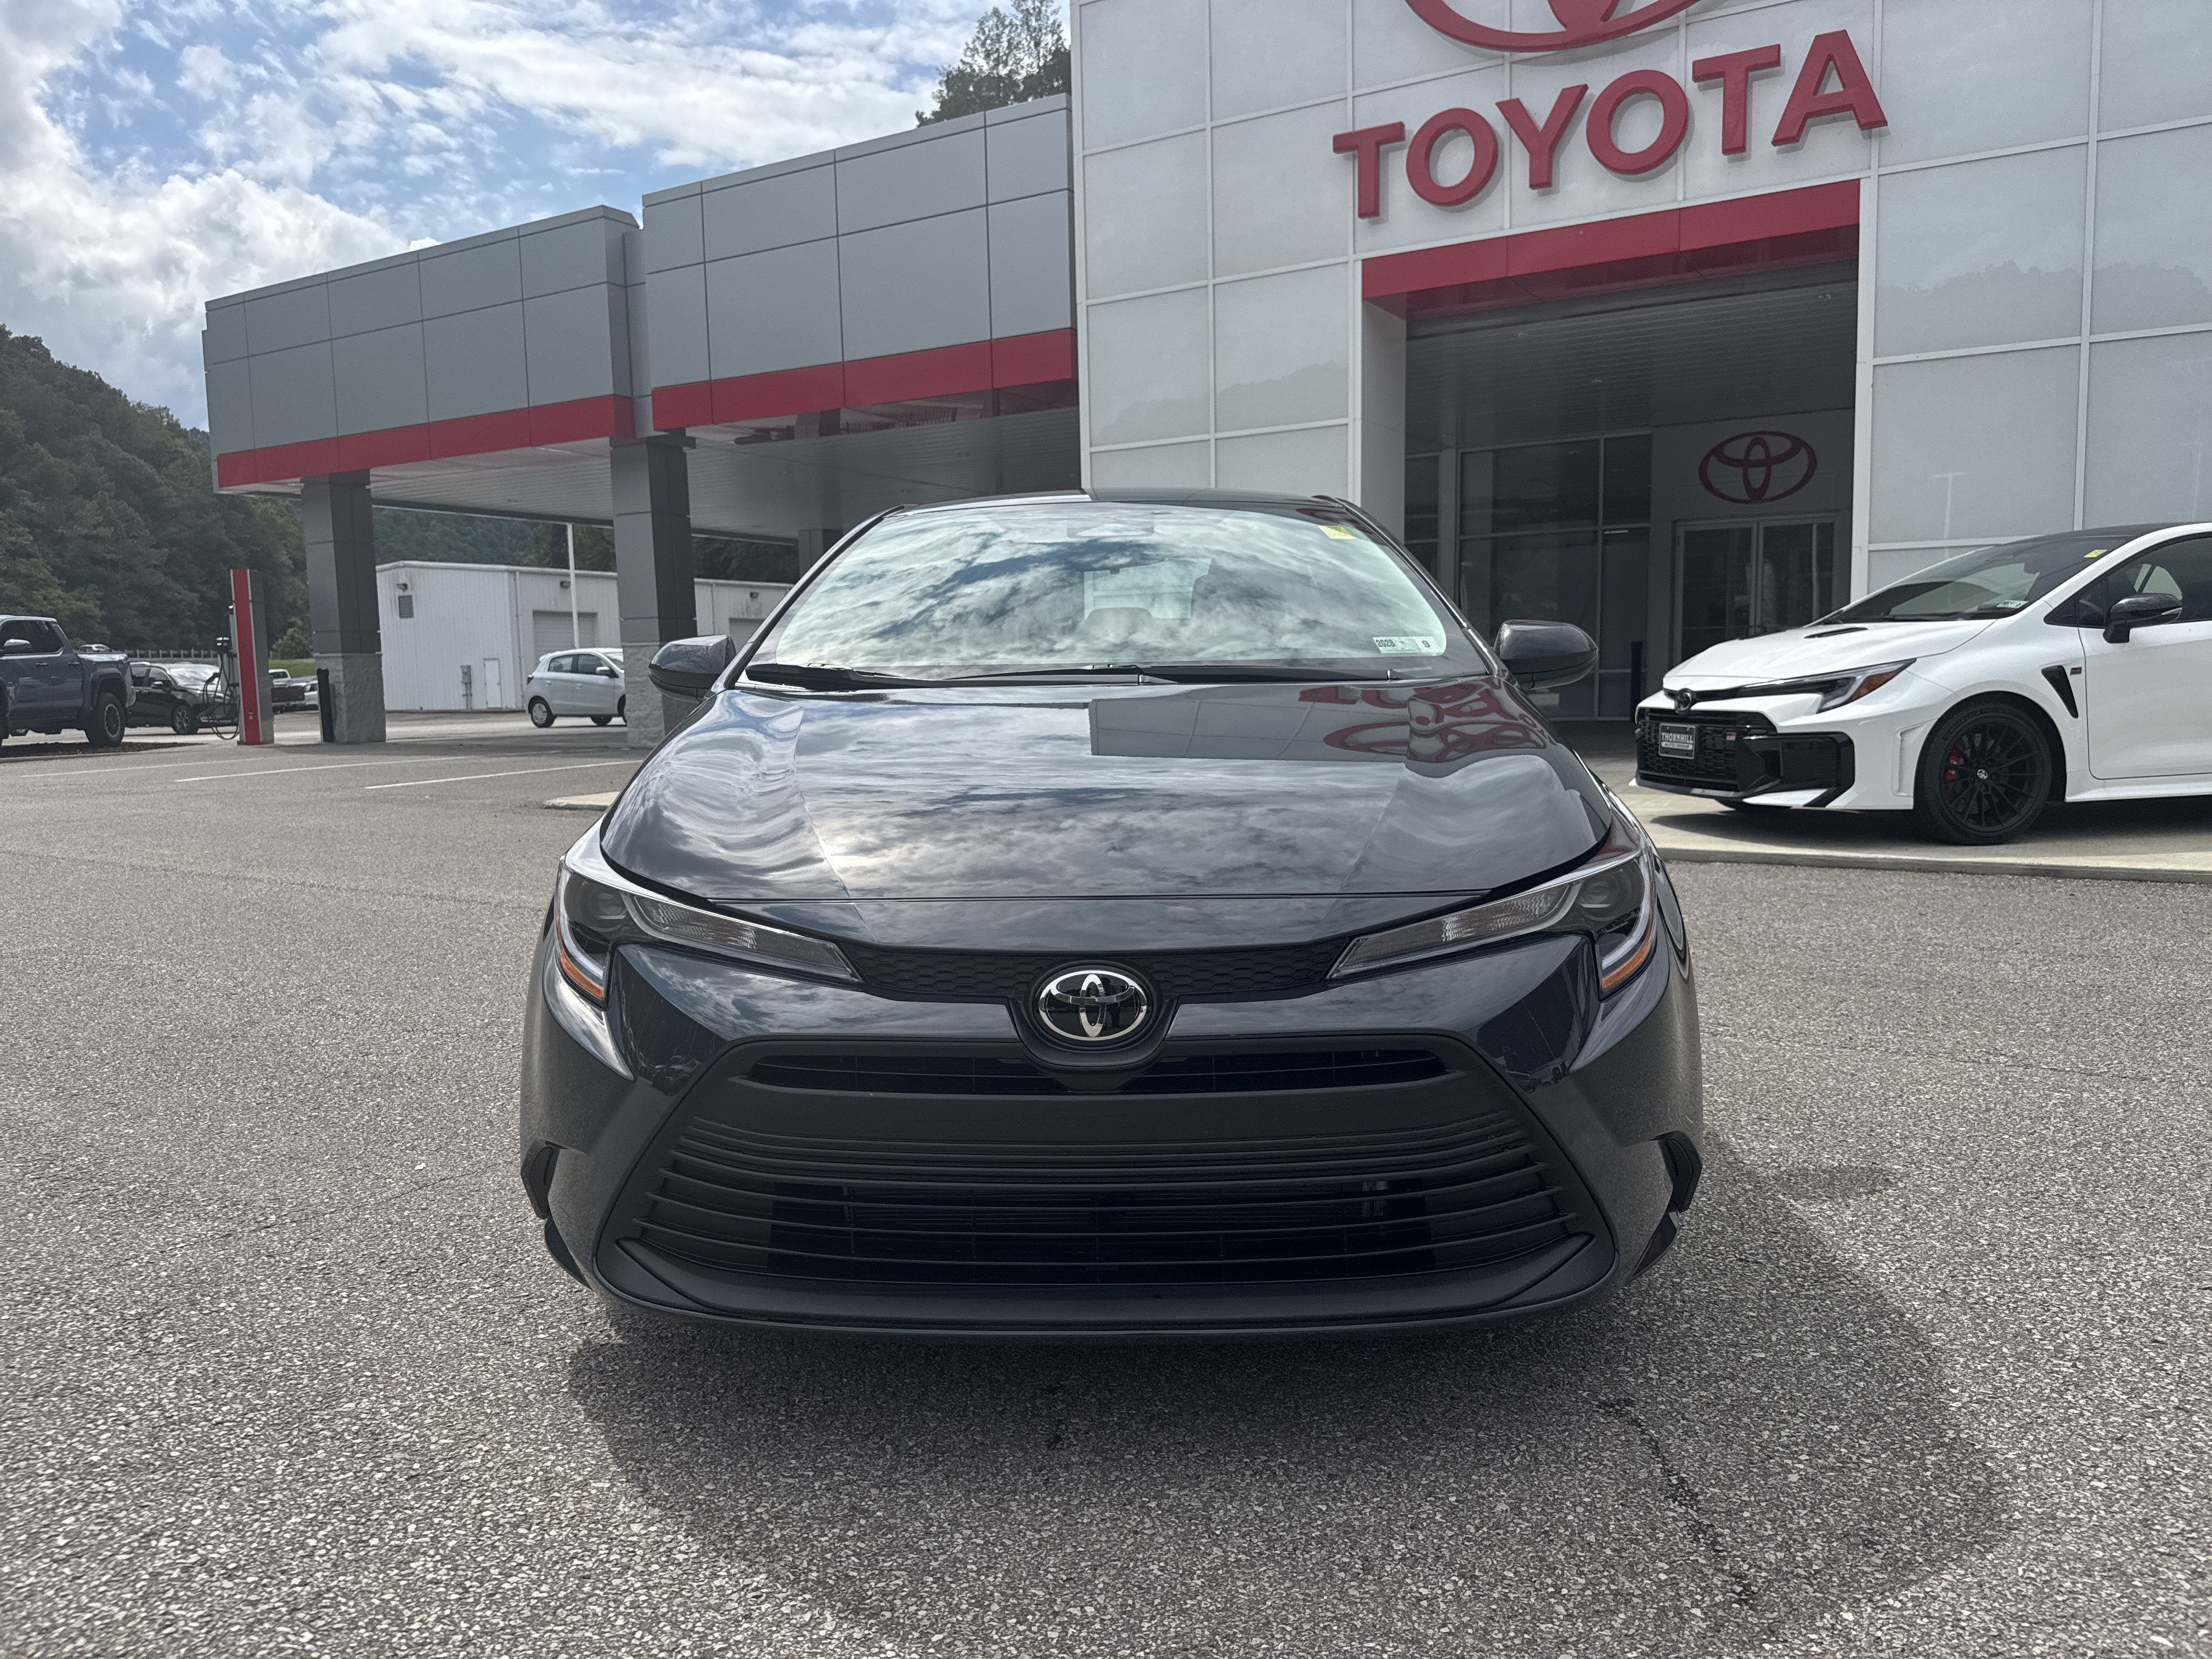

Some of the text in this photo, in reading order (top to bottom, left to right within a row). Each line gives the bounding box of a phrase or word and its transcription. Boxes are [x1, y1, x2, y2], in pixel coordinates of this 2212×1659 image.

[1333, 29, 1888, 219] TOYOTA
[1375, 639, 1396, 647] 2028
[1661, 732, 1694, 743] THORNHILL
